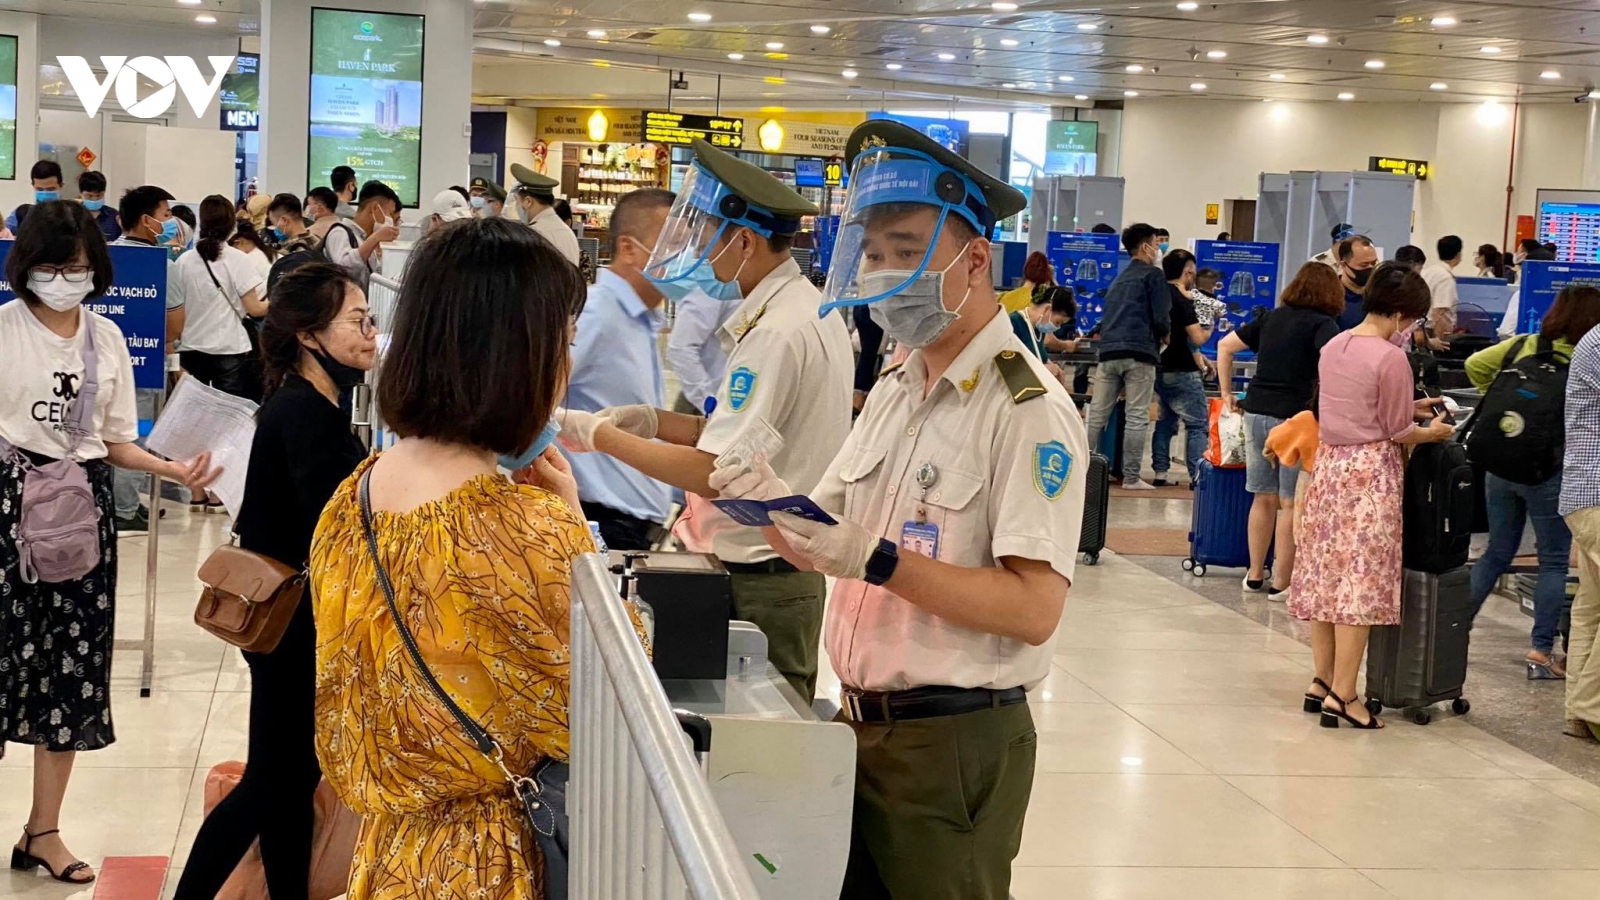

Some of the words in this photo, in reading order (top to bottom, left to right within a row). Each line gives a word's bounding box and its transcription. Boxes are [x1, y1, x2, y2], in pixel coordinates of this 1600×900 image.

[338, 60, 369, 71] HAVEN
[371, 62, 396, 72] PARK
[227, 110, 259, 126] MEN
[346, 157, 364, 166] 15%
[826, 164, 840, 180] 10
[120, 286, 142, 299] VẠCH
[144, 284, 157, 298] ĐỎ
[93, 304, 107, 314] RED
[109, 305, 125, 315] LINE
[144, 338, 159, 348] BAY
